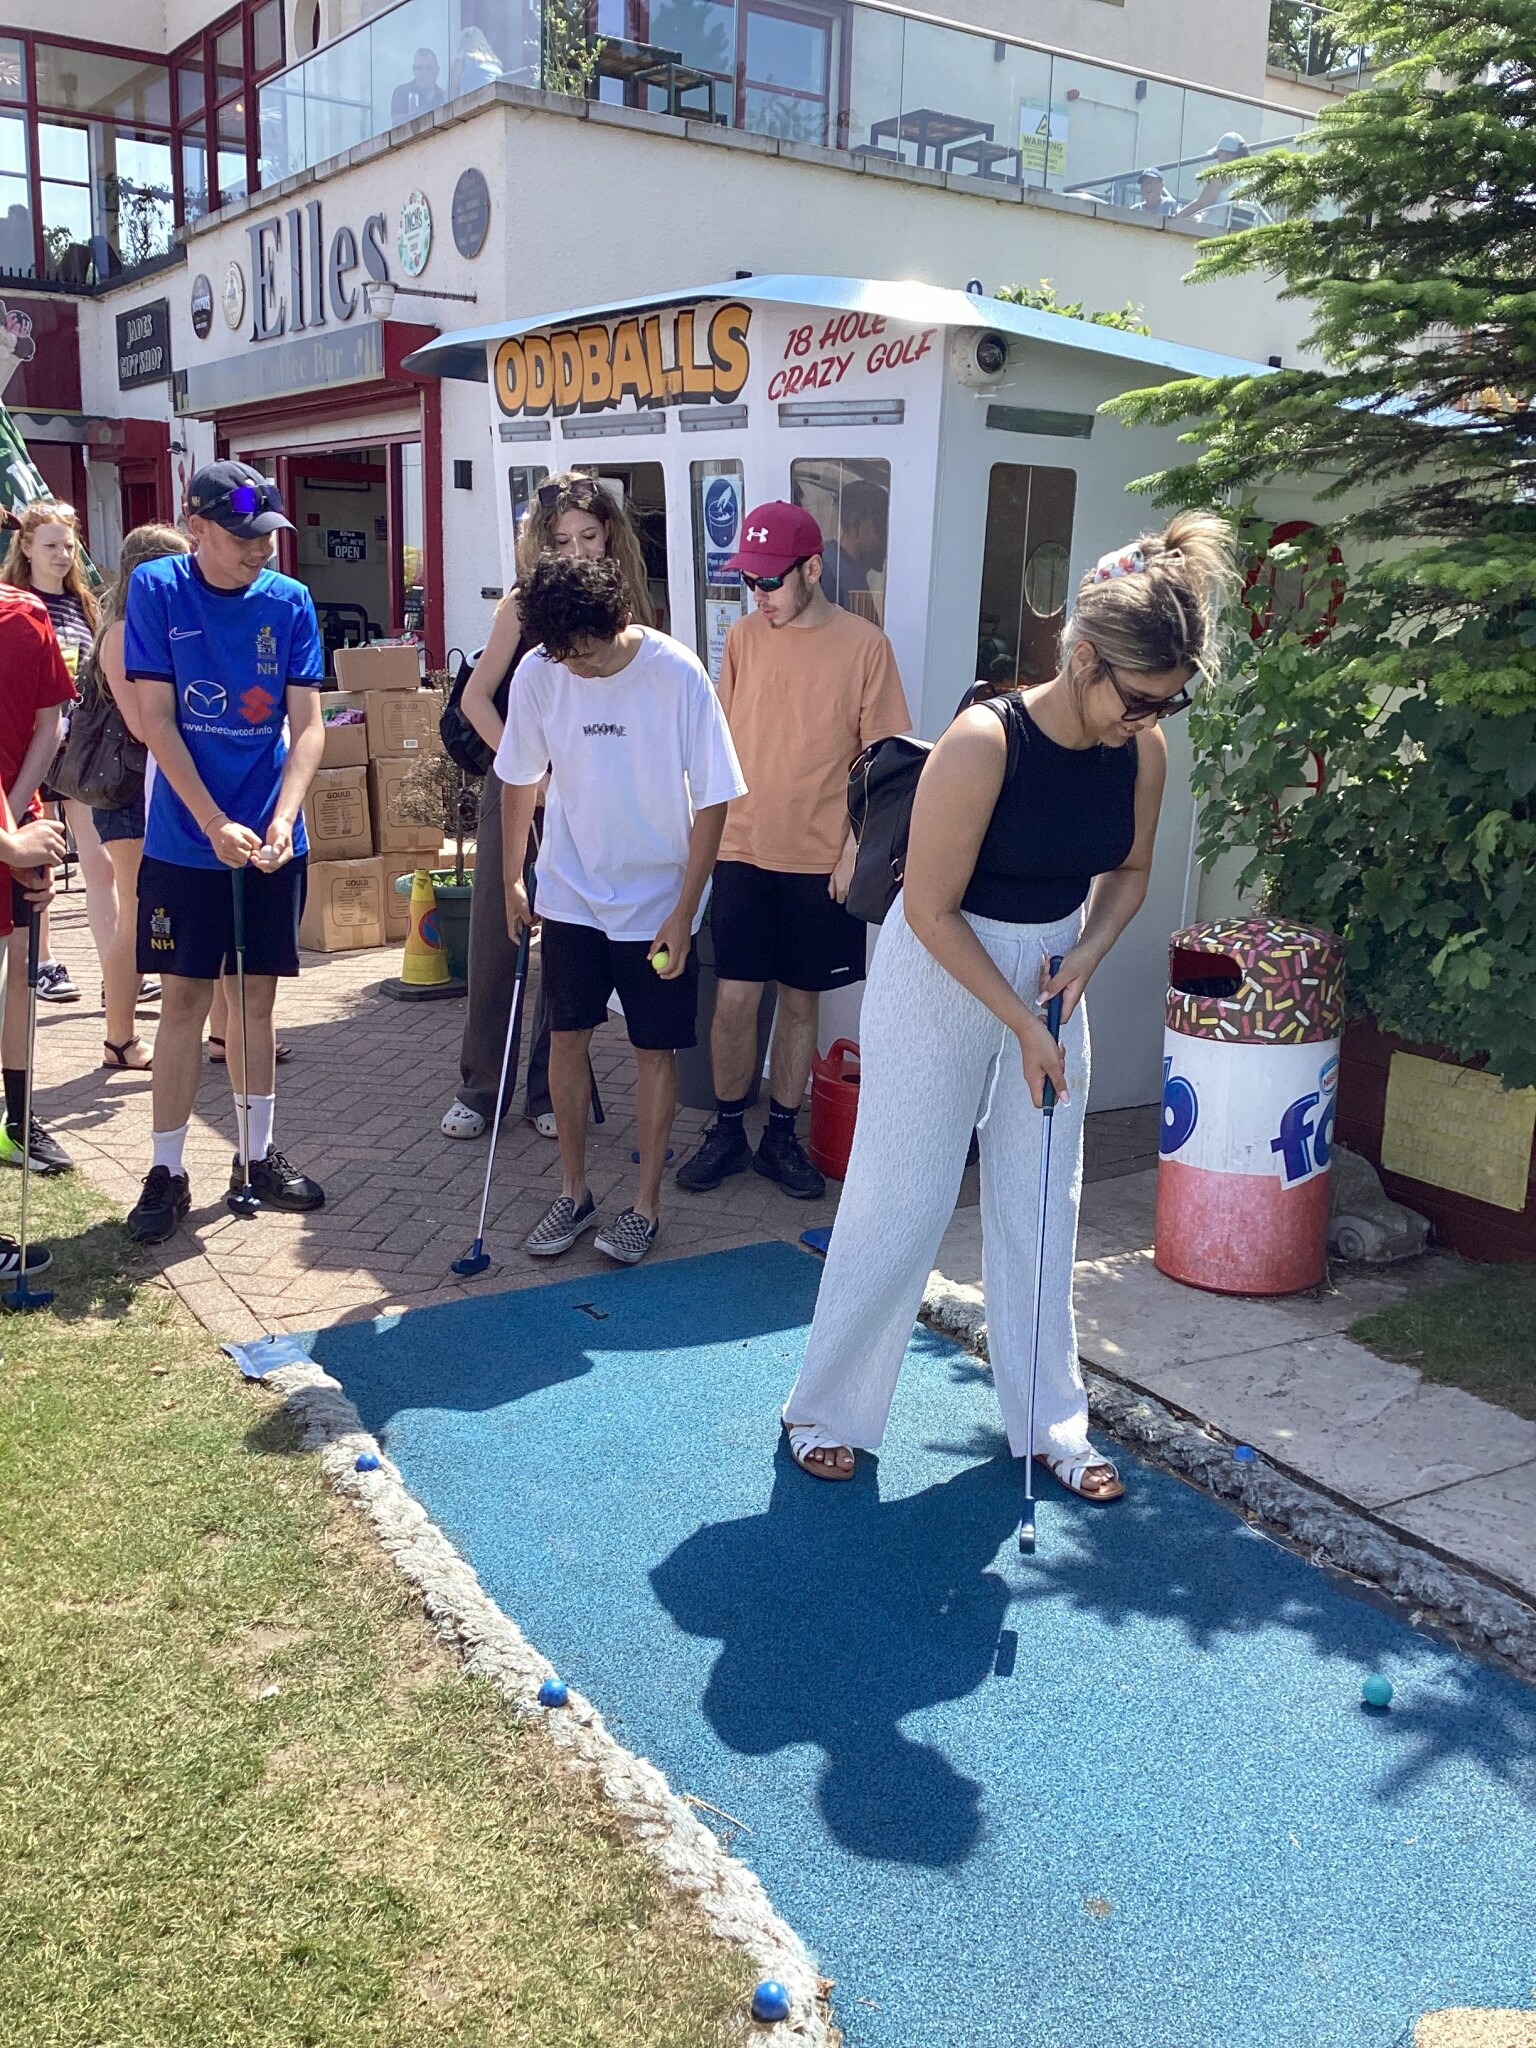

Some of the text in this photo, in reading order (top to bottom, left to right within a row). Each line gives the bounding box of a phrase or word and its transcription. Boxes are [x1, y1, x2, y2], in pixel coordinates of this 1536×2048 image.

[245, 199, 387, 342] Elles
[126, 313, 153, 349] JADES
[784, 311, 887, 359] 18 HOLE
[120, 346, 163, 379] GIFT SHOP
[313, 341, 344, 378] Bar
[494, 302, 753, 417] ODDBALLS
[768, 328, 937, 400] CRAZY GOLF
[335, 546, 360, 558] OPEN
[717, 627, 728, 636] KIN
[257, 662, 279, 675] NH
[326, 790, 351, 799] GOULD
[345, 879, 369, 887] GOULD
[151, 938, 175, 950] NH
